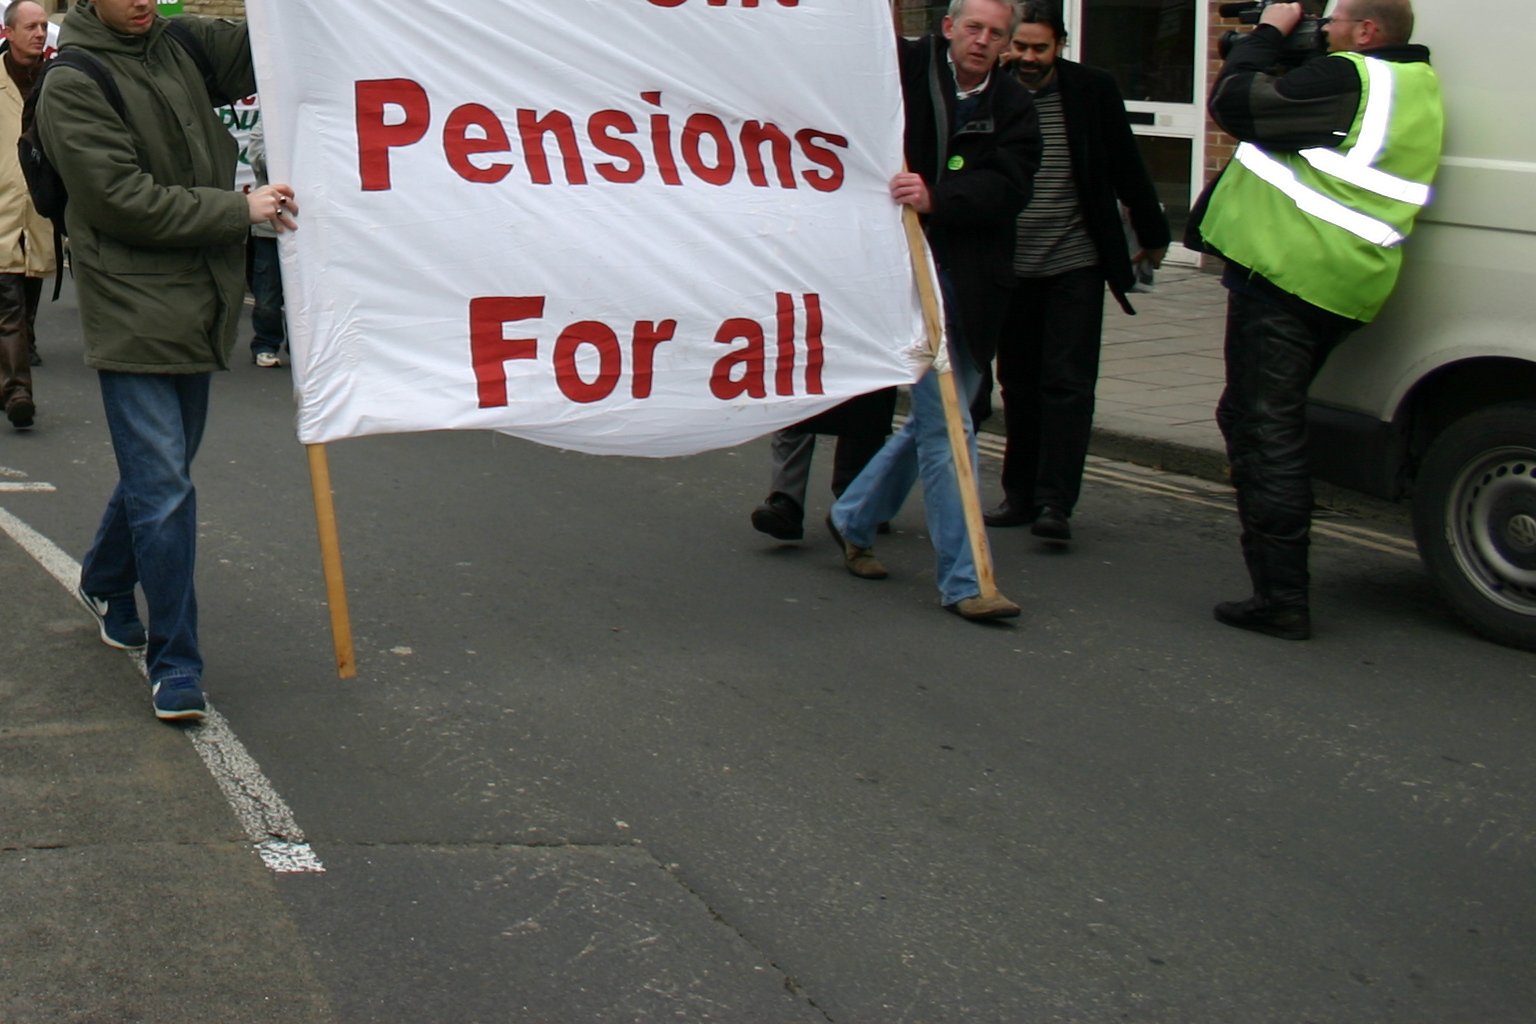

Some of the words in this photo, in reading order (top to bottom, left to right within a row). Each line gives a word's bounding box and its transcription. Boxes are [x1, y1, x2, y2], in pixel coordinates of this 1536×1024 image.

[354, 77, 850, 193] Pensions
[469, 294, 678, 409] For
[708, 291, 826, 401] all
